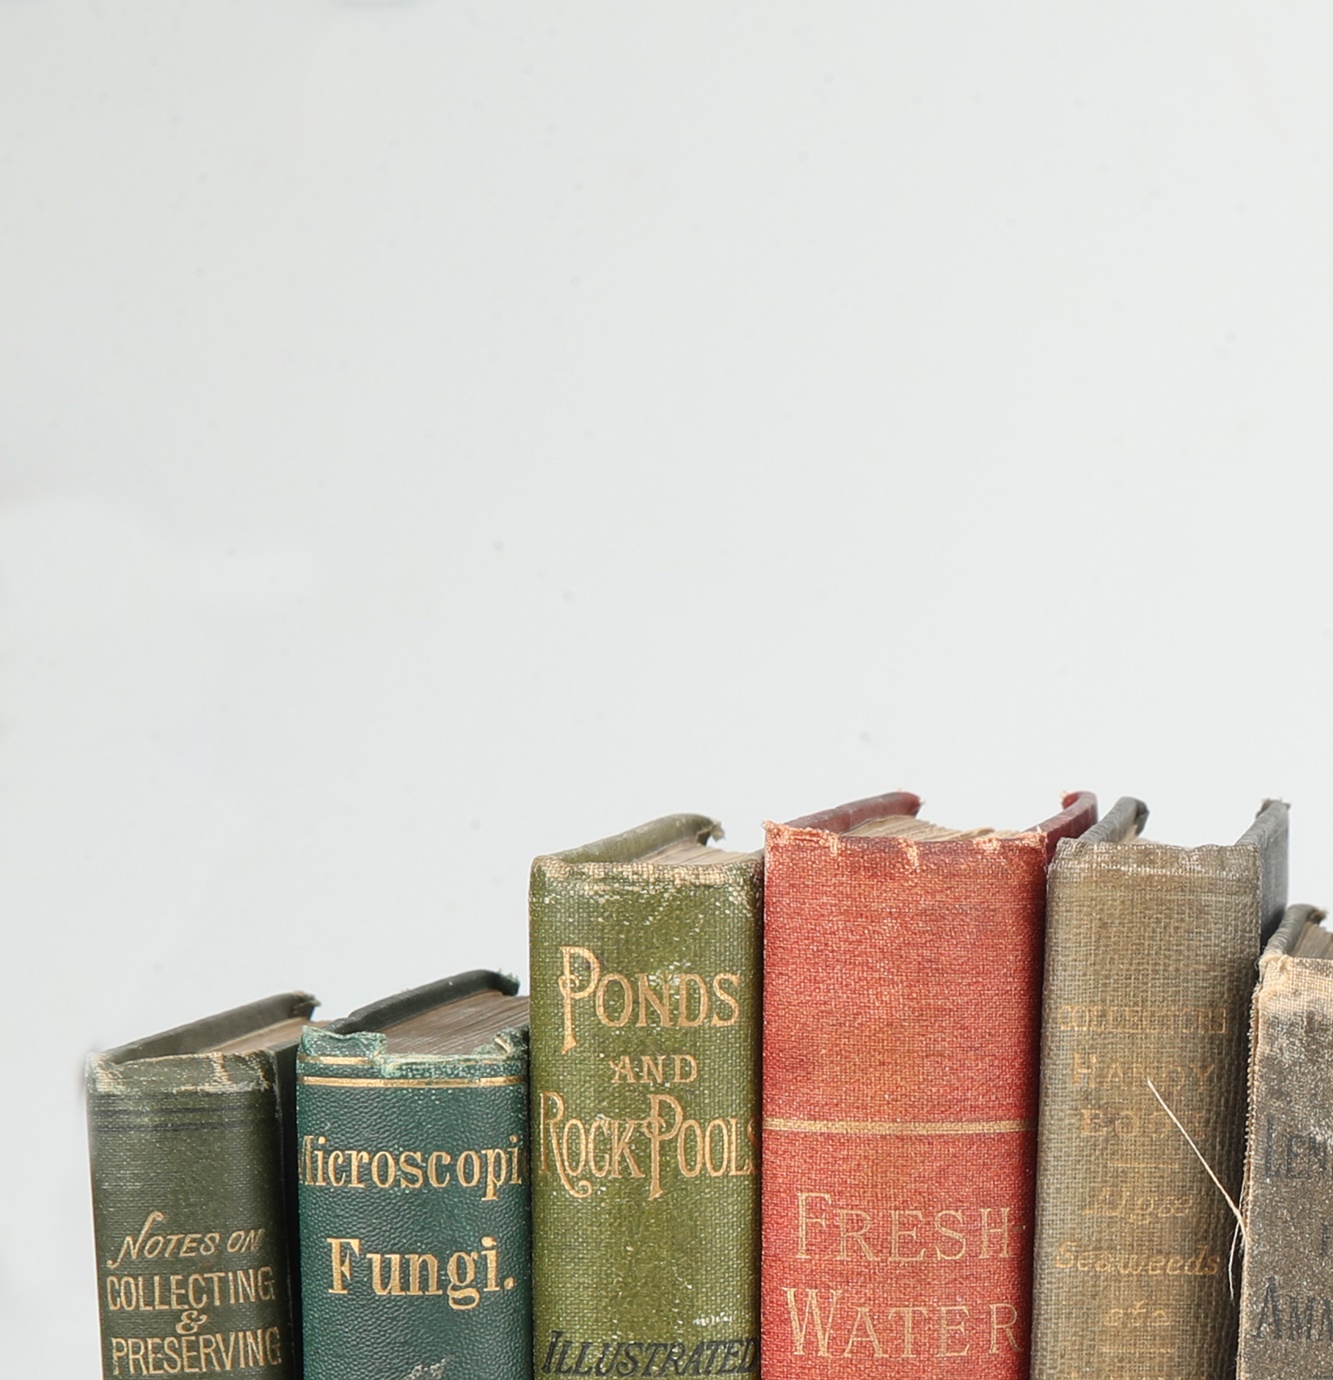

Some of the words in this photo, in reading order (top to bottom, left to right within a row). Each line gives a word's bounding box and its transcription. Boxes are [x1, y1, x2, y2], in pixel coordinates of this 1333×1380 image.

[557, 944, 742, 1055] PONDS
[609, 1053, 698, 1085] AND
[227, 1228, 266, 1253] ON
[107, 1266, 276, 1311] COLLECTING
[326, 1236, 516, 1310] Fungi.
[176, 1310, 208, 1334] &
[781, 1287, 1023, 1357] WATER
[112, 1326, 282, 1375] PRESERVING
